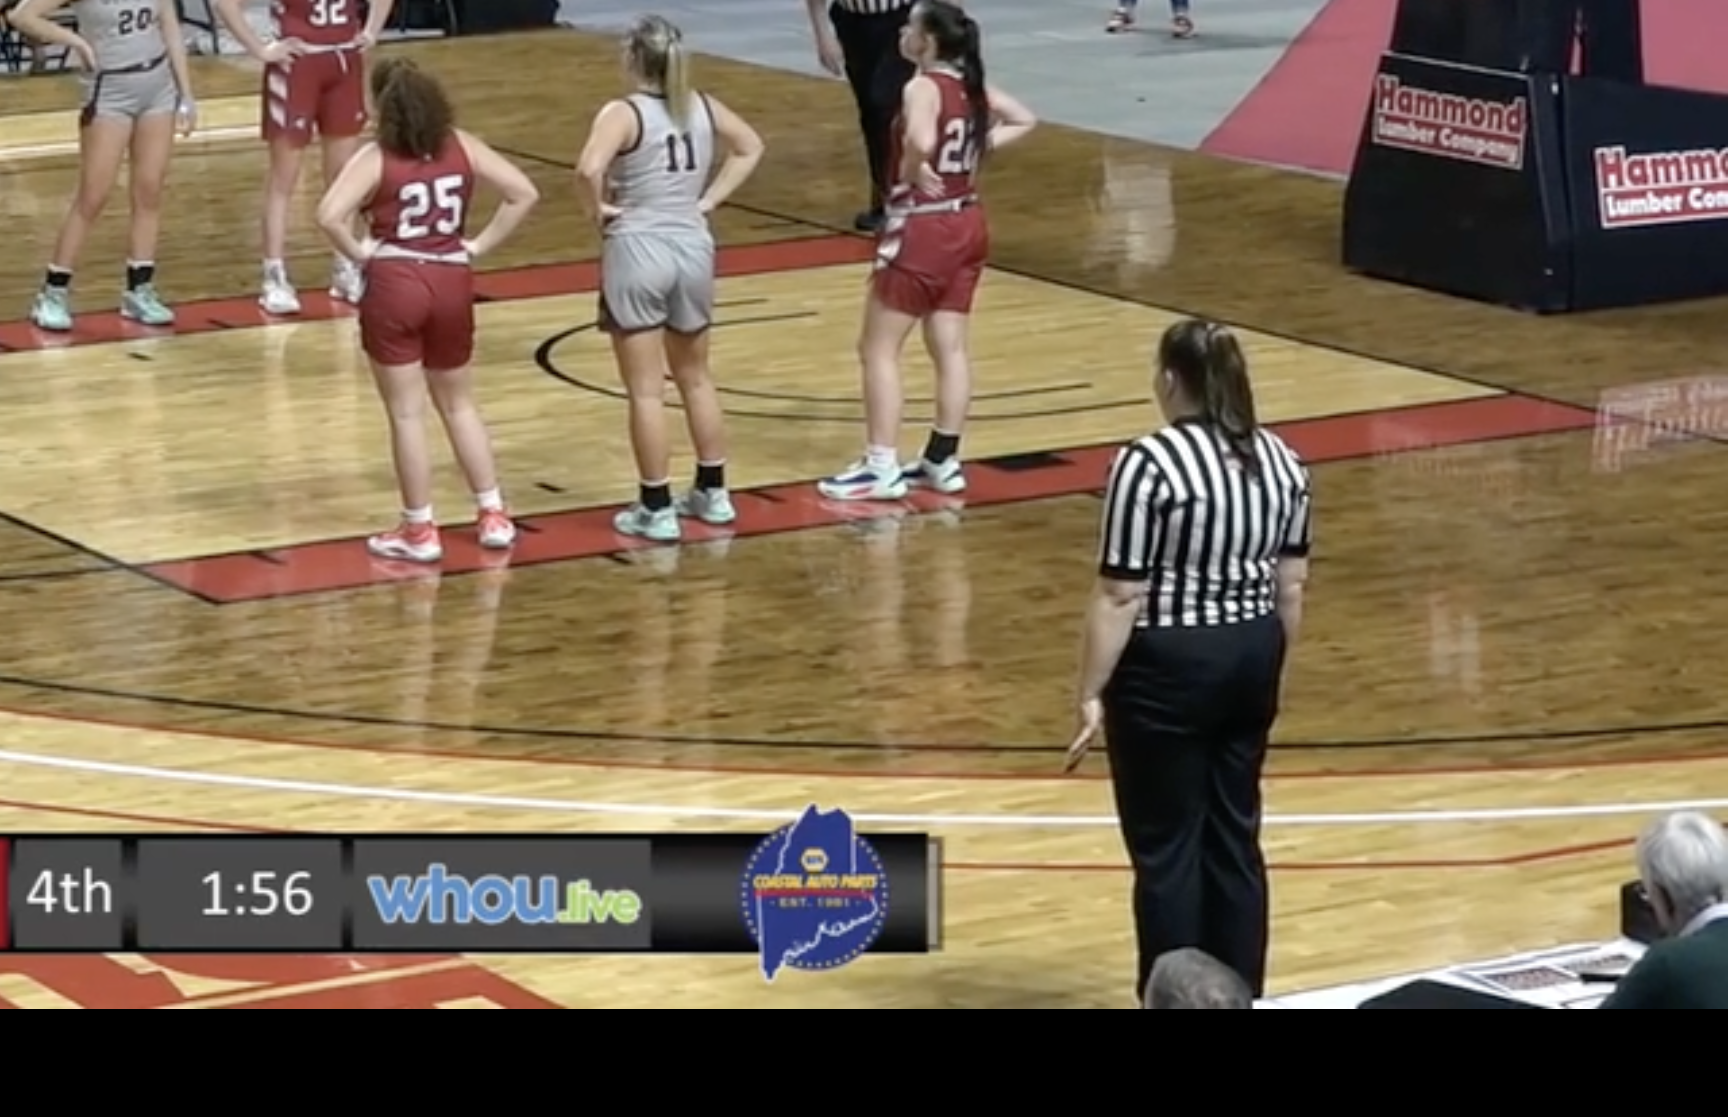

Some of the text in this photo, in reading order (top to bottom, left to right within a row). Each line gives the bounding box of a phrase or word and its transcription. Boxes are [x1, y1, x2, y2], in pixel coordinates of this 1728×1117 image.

[117, 7, 153, 35] 20
[1378, 73, 1527, 134] Hammond
[665, 131, 698, 173] 11
[1378, 115, 1520, 163] Lumber Company
[396, 173, 464, 240] 25
[1605, 190, 1685, 218] Lumber
